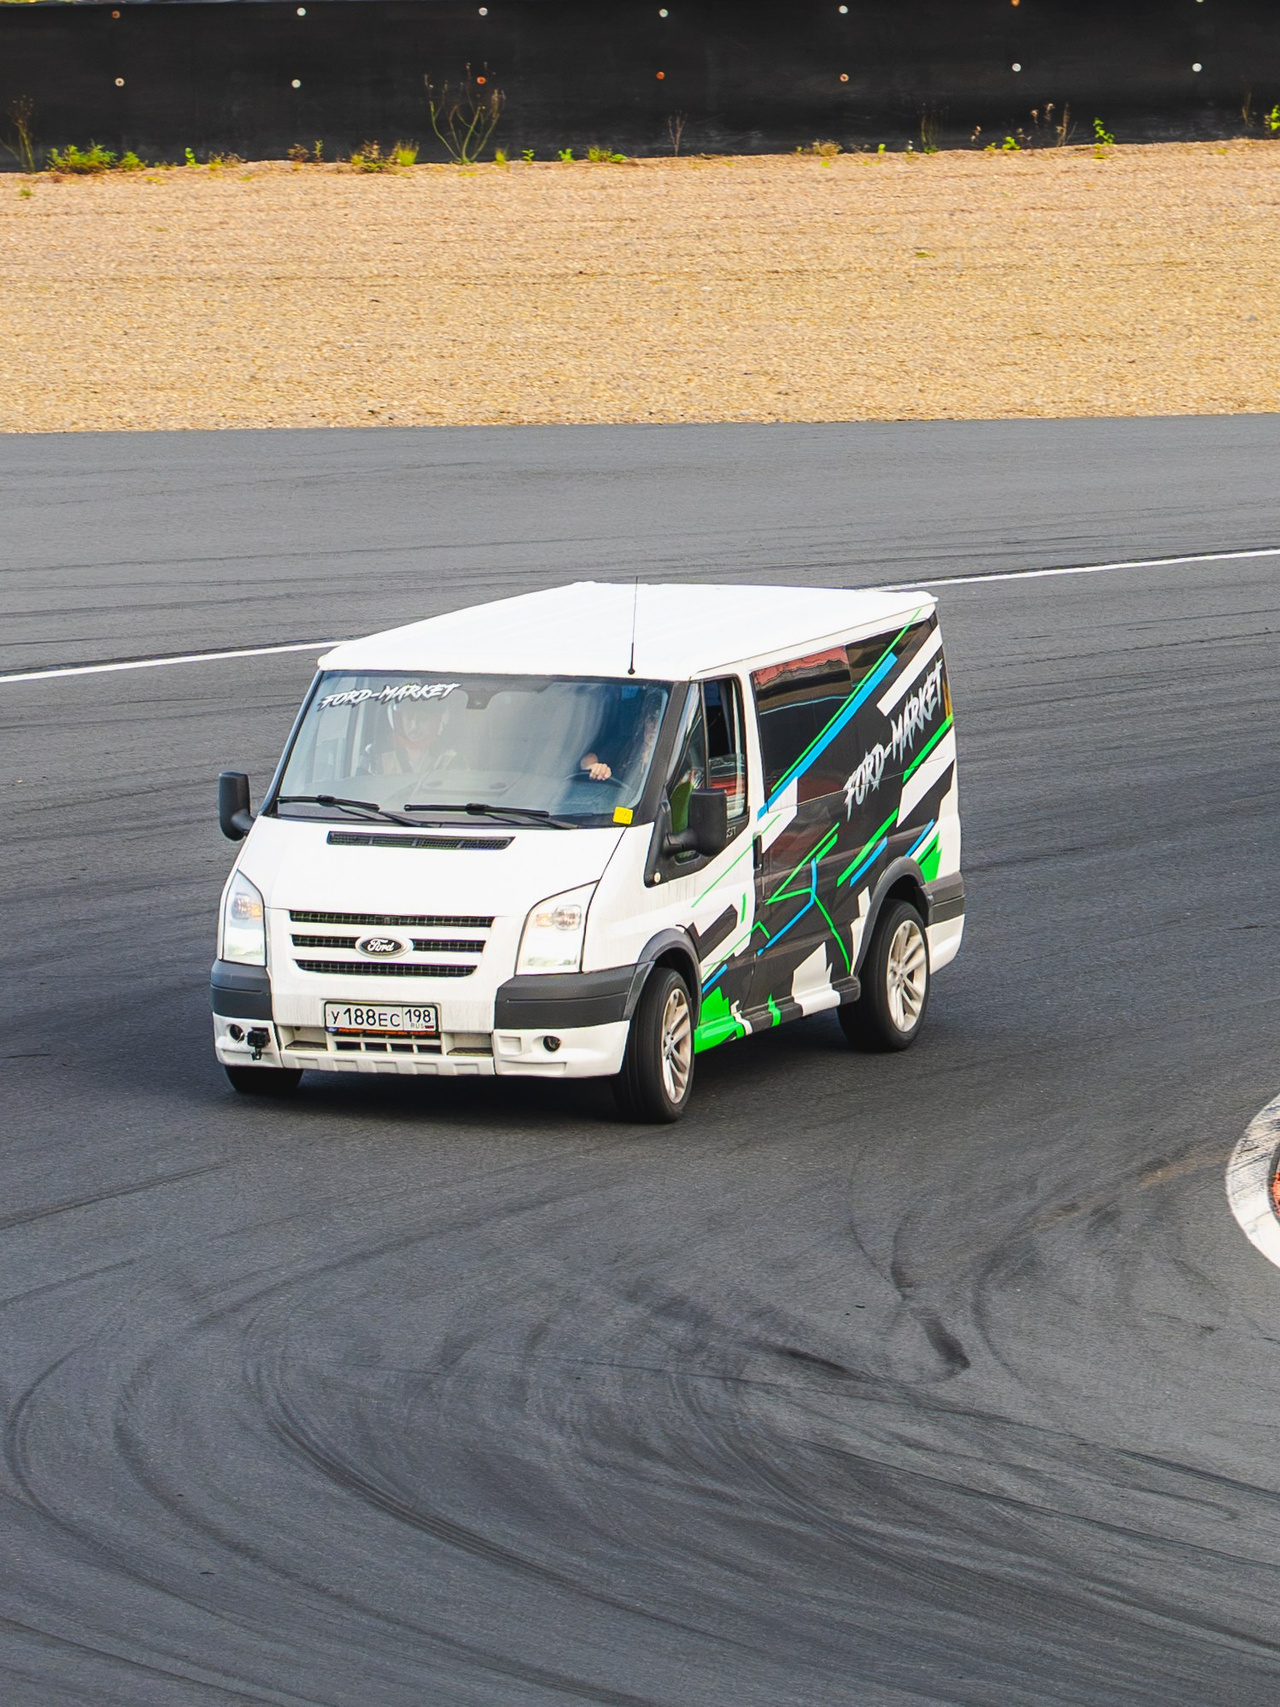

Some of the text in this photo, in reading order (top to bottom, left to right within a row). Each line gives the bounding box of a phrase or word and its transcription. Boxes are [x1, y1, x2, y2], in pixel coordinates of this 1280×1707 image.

[319, 683, 460, 711] FORD-MARKET
[844, 657, 945, 820] FORD-MARKET
[367, 939, 395, 952] Ford
[405, 1008, 432, 1024] 198
